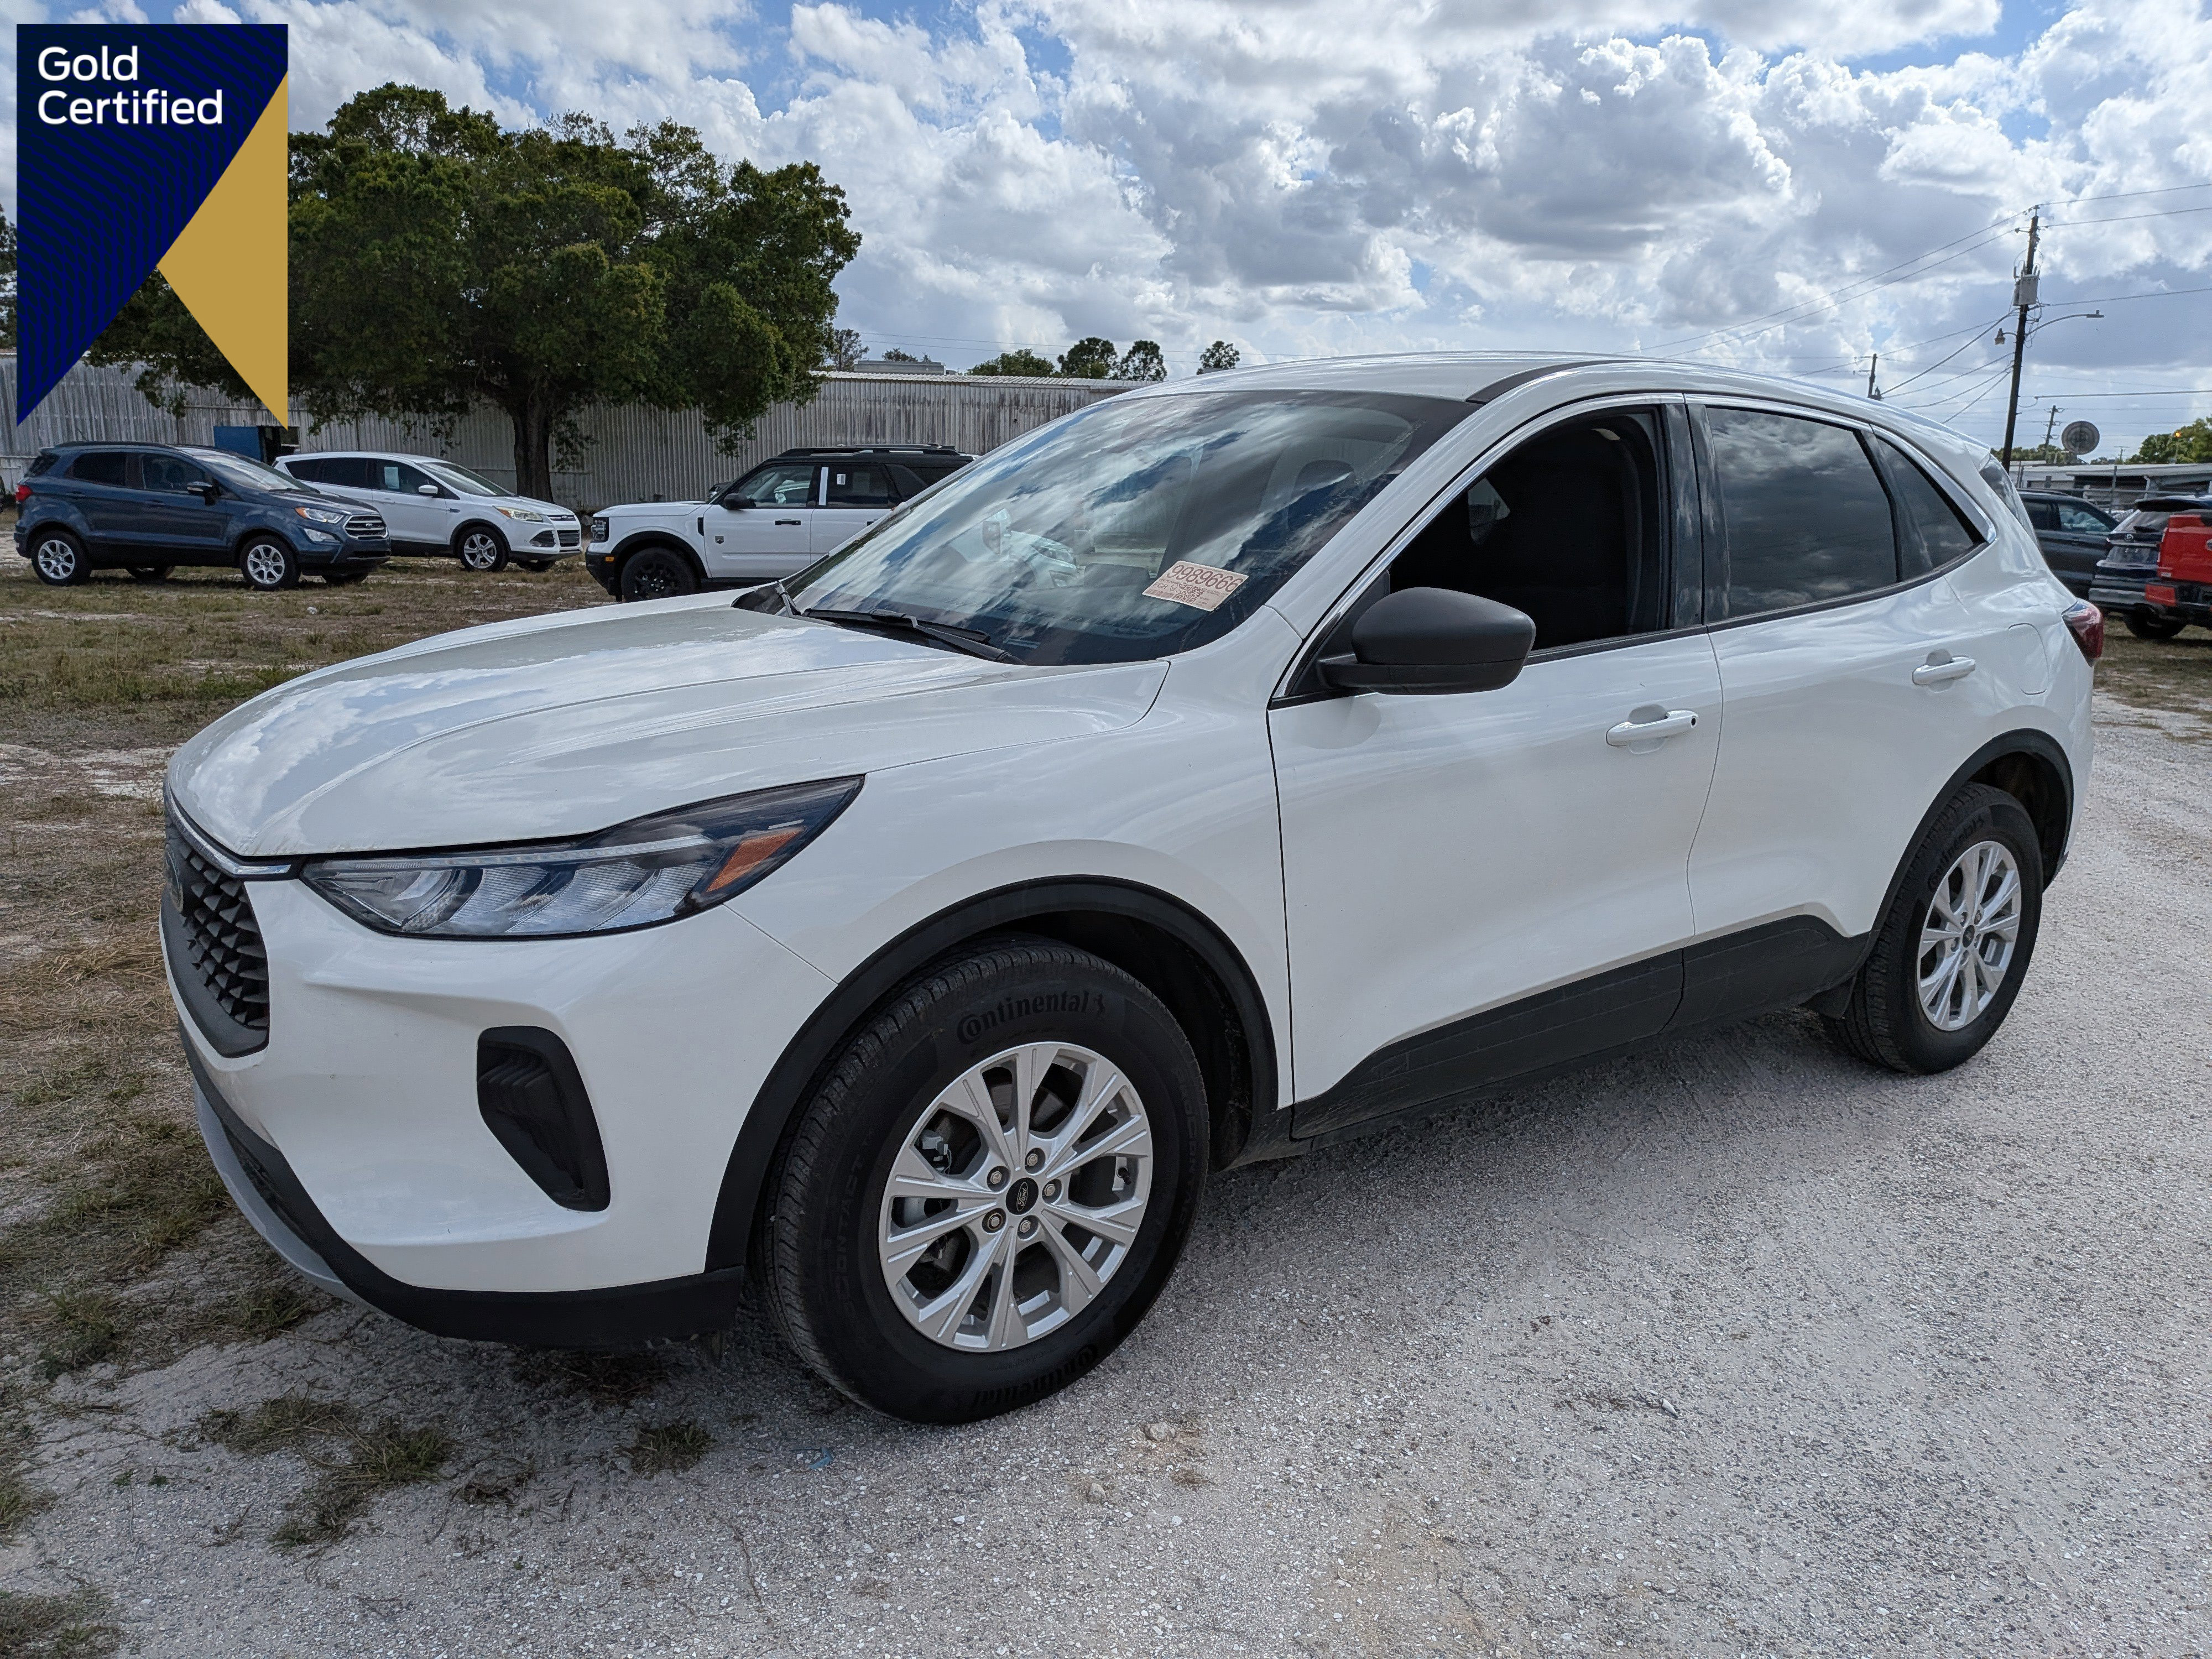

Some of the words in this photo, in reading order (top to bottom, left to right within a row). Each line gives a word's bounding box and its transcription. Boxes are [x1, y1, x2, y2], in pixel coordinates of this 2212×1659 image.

[1166, 565, 1244, 593] 9989666
[956, 990, 1090, 1044] Continental
[1018, 1186, 1027, 1208] Ford
